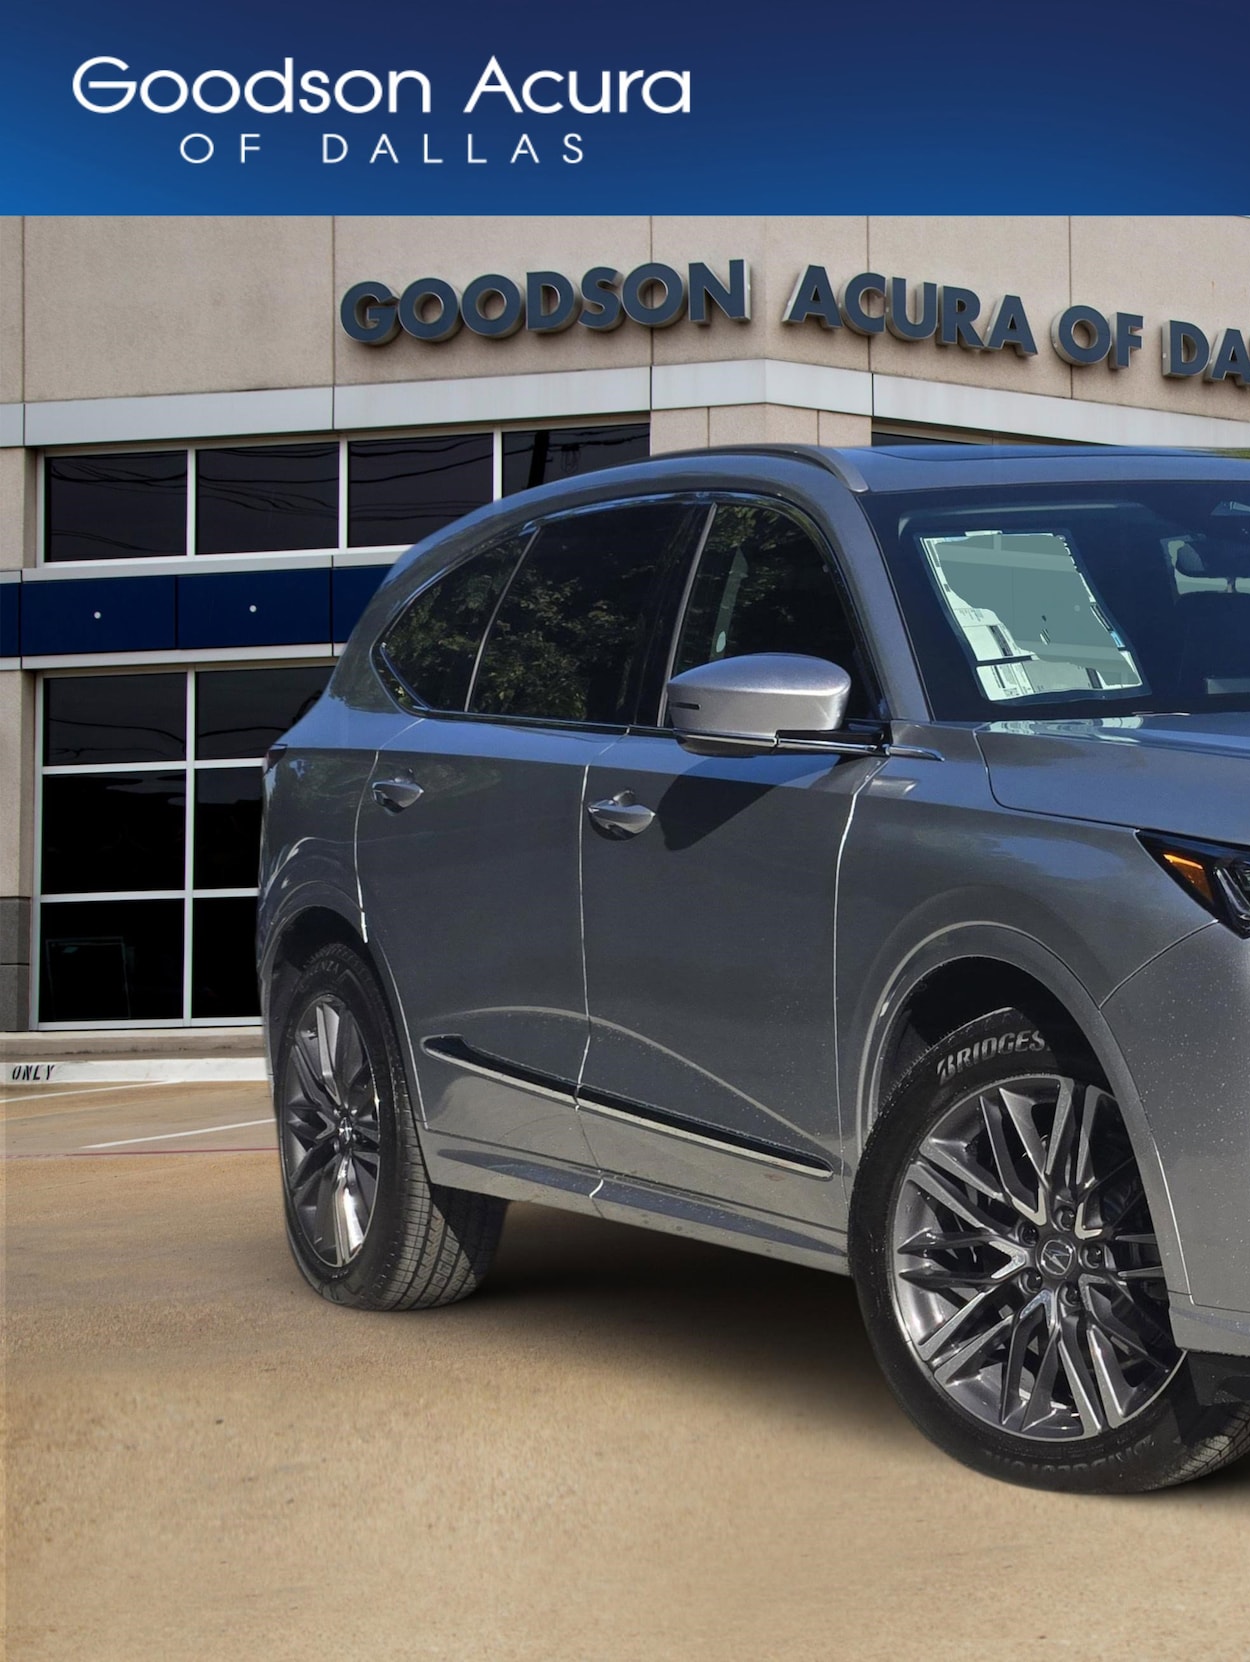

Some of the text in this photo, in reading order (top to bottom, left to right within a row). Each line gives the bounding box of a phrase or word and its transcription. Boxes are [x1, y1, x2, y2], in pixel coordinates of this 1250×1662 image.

[340, 259, 750, 344] GOODSON
[784, 265, 1038, 357] ACURA
[1050, 304, 1144, 369] OF
[12, 1064, 55, 1080] ONLY
